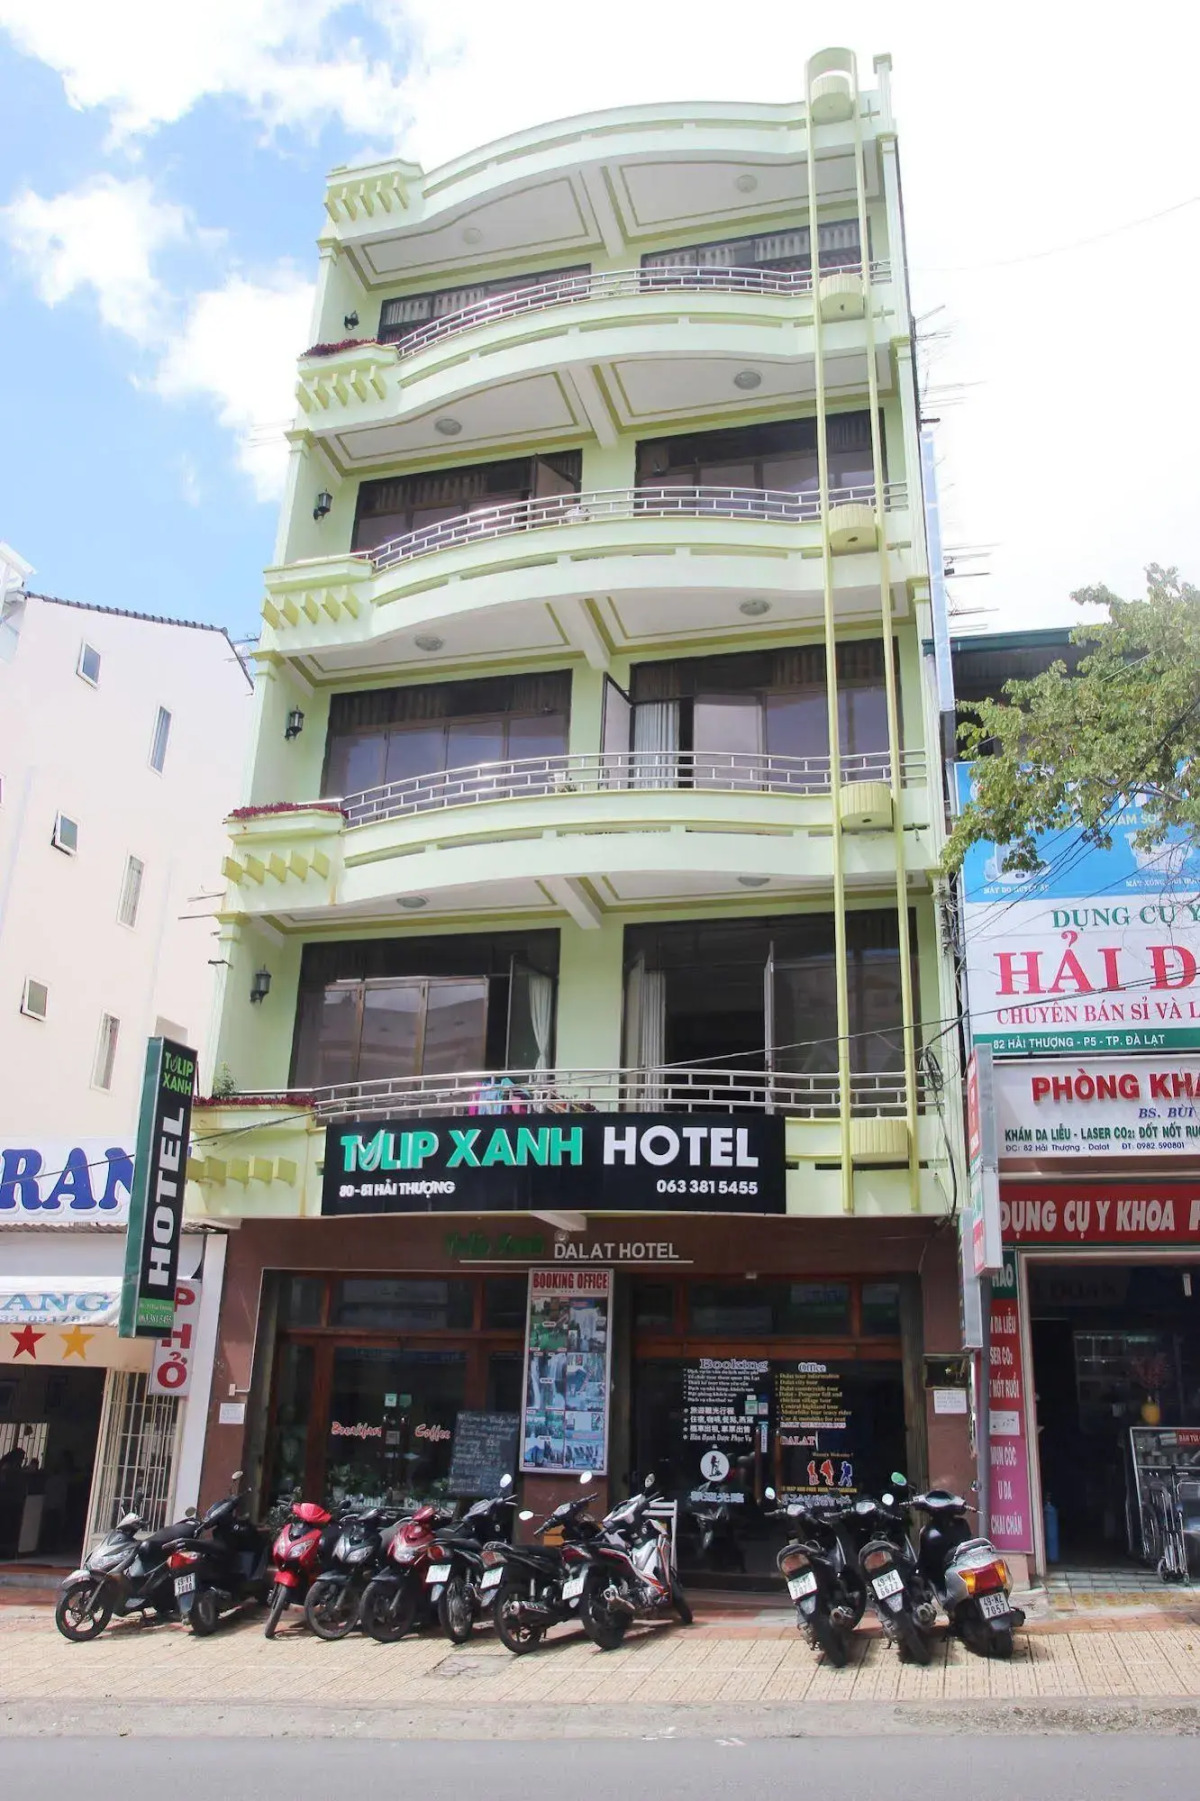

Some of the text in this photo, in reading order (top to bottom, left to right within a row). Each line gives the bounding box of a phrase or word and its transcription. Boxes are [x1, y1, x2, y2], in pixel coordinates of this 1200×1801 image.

[1052, 906, 1130, 931] DỤNG
[1139, 904, 1176, 927] CỤ
[993, 930, 1126, 996] HẢI
[997, 1000, 1077, 1025] CHUYÊN
[1084, 1003, 1125, 1021] BÁN
[1131, 996, 1149, 1020] SỈ
[1154, 997, 1182, 1020] VÀ
[993, 1038, 1005, 1049] 82
[1007, 1034, 1026, 1048] HẢI
[1028, 1036, 1074, 1050] THƯỢNG
[1084, 1036, 1097, 1046] P5
[1105, 1036, 1123, 1046] TP.
[1125, 1032, 1142, 1046] ĐÀ
[1144, 1034, 1165, 1047] LẠT
[165, 1051, 194, 1077] TULIP
[162, 1072, 192, 1096] XANH
[1032, 1068, 1141, 1101] PHÒNG
[1138, 1104, 1194, 1118] BS. BÙI
[1005, 1126, 1032, 1141] KHÁM
[1035, 1128, 1048, 1140] DA
[1081, 1126, 1111, 1139] LASER
[1139, 1122, 1158, 1138] ĐỐT
[1162, 1121, 1181, 1138] NỐT
[340, 1125, 759, 1172] TULIP XANH HOTEL
[1052, 1143, 1080, 1152] Thượng
[1088, 1143, 1110, 1151] Dalat
[148, 1107, 185, 1287] HOTEL
[374, 1178, 398, 1197] HẢI
[399, 1180, 456, 1198] THƯỢNG
[1001, 1200, 1057, 1239] DỤNG
[1063, 1200, 1091, 1239] CỤ
[1095, 1200, 1111, 1231] Y
[1116, 1200, 1175, 1232] KHOA
[554, 1243, 679, 1259] DALAT HOTEL
[533, 1272, 607, 1289] BOOKING OFFICE
[156, 1287, 196, 1389] PHỞ
[700, 1358, 768, 1372] Booking
[798, 1362, 827, 1373] Office
[414, 1423, 451, 1442] Coffee
[1004, 1481, 1013, 1500] DA
